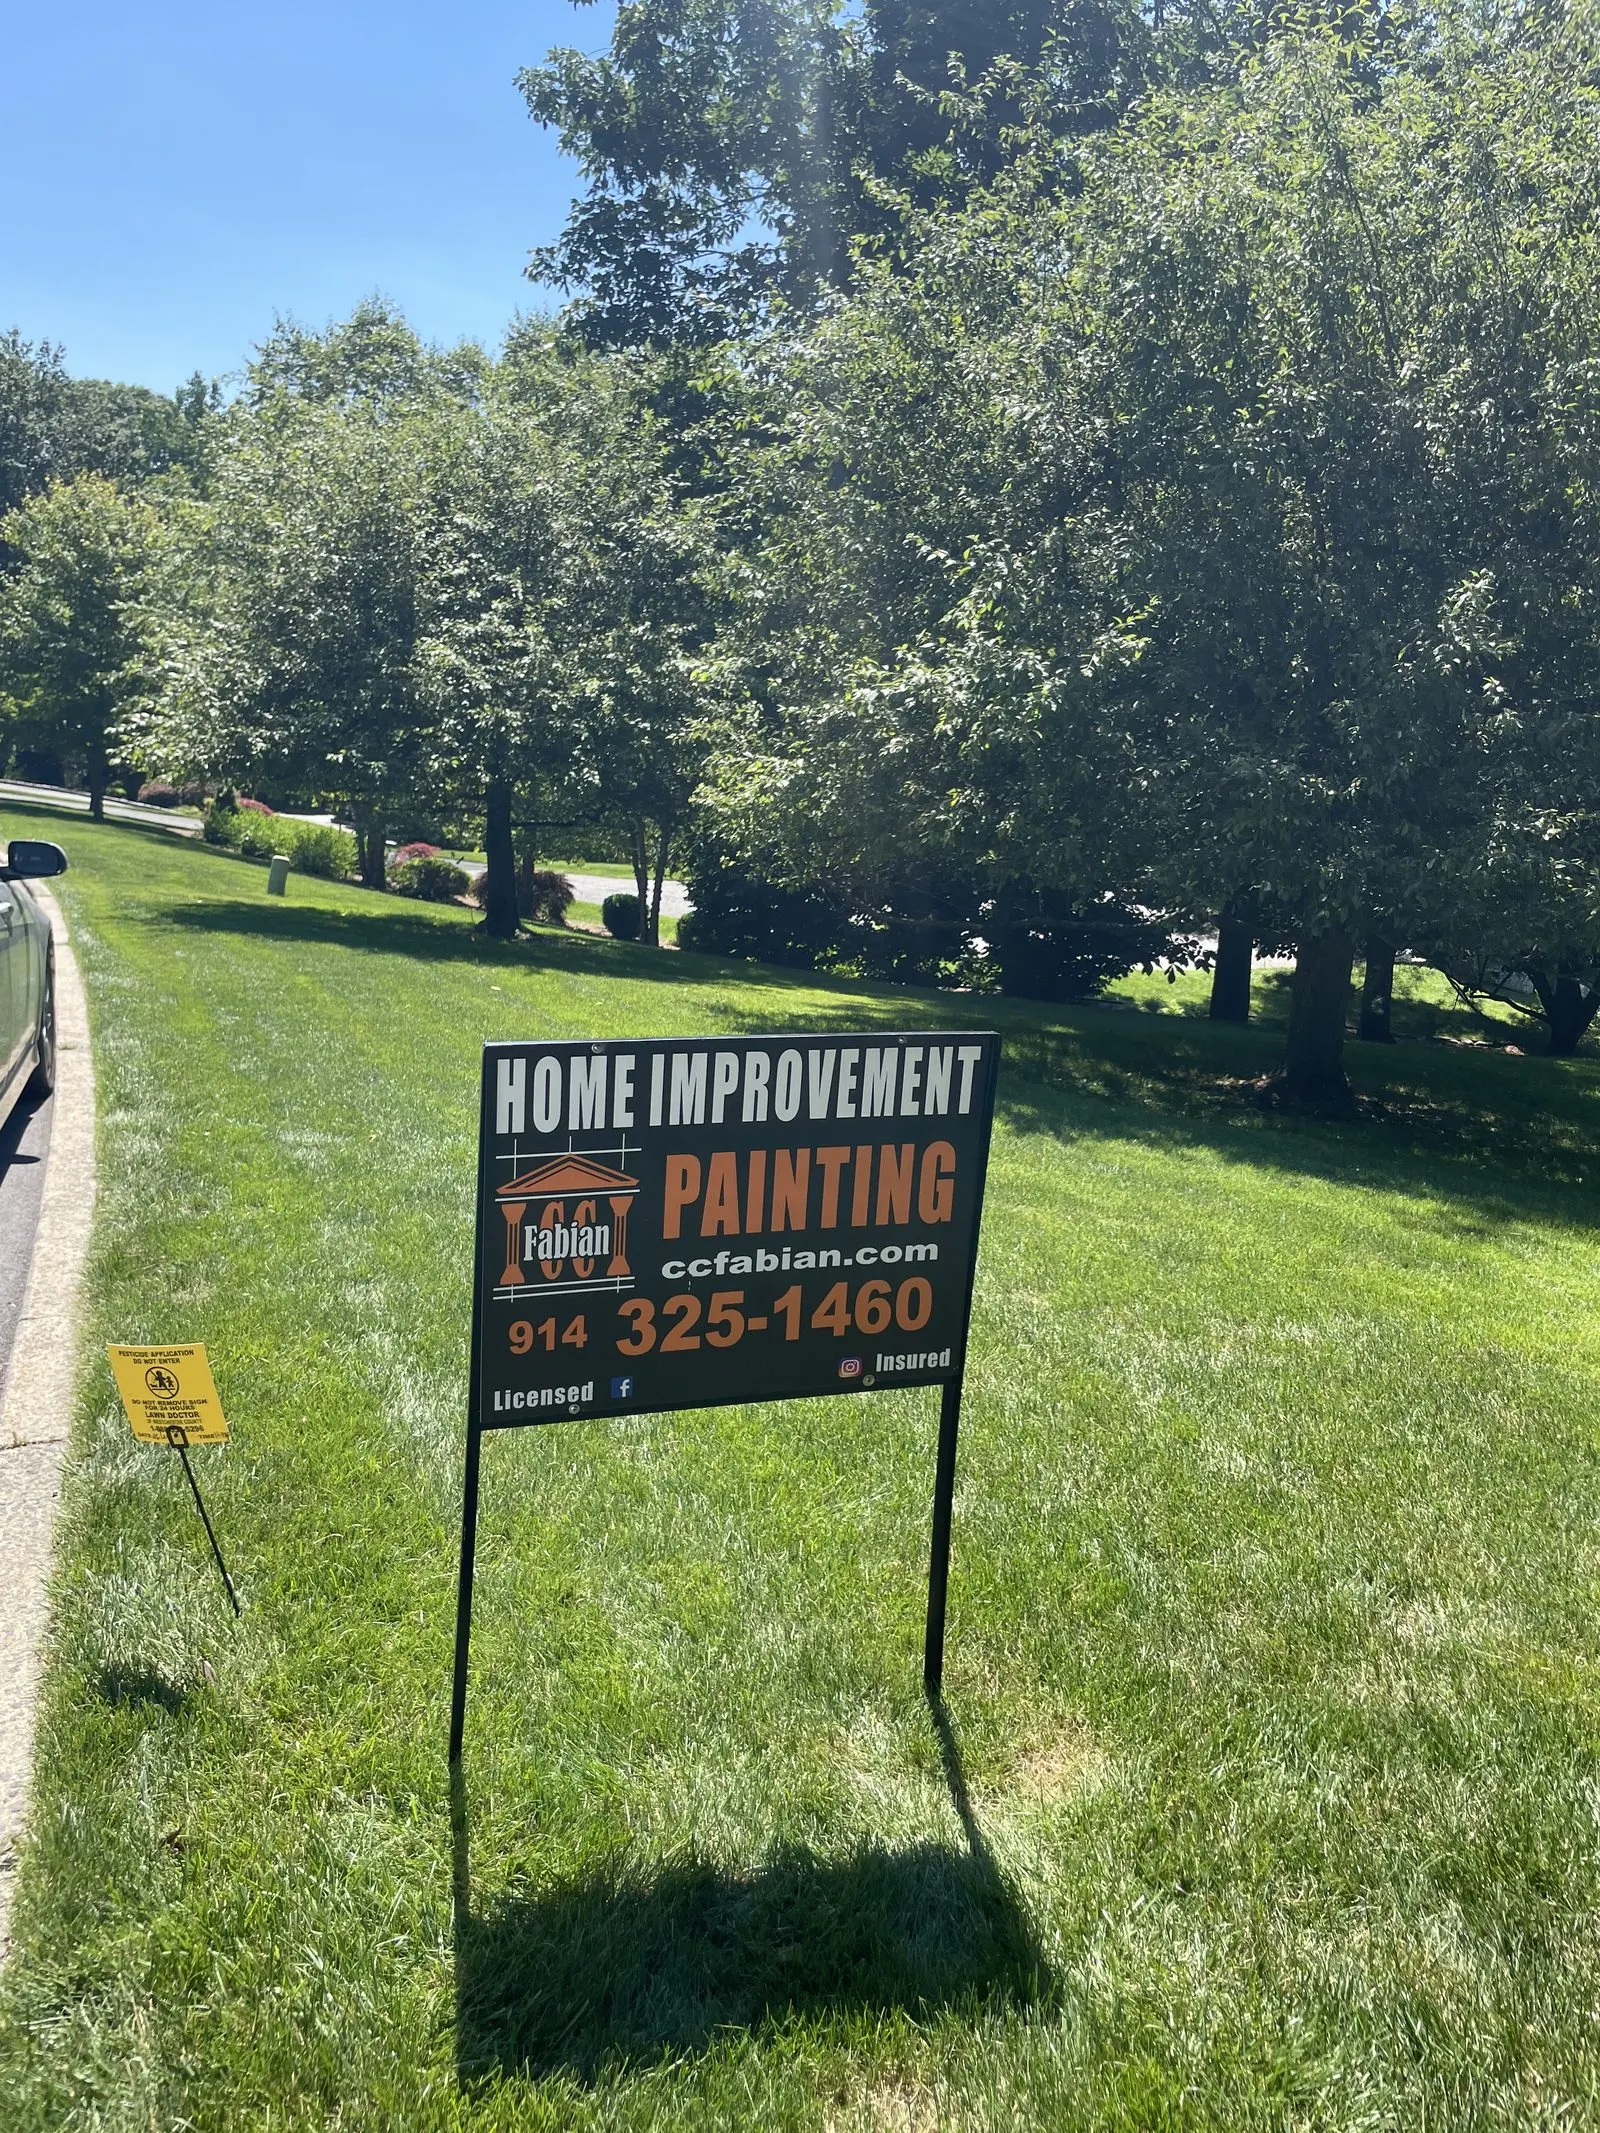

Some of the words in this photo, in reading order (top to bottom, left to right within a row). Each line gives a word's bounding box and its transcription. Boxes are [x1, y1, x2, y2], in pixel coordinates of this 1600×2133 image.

[495, 1054, 636, 1135] HOME
[648, 1046, 983, 1127] IMPROVEMENT
[662, 1140, 958, 1240] PAINTING
[523, 1221, 610, 1261] Fabian
[661, 1241, 939, 1280] ccfabian.com
[508, 1314, 588, 1355] 914
[615, 1276, 933, 1356] 325-1460
[119, 1350, 149, 1358] PESTICIDE
[151, 1349, 194, 1357] APPLICATION
[875, 1348, 951, 1373] Insured
[493, 1381, 594, 1412] Licensed
